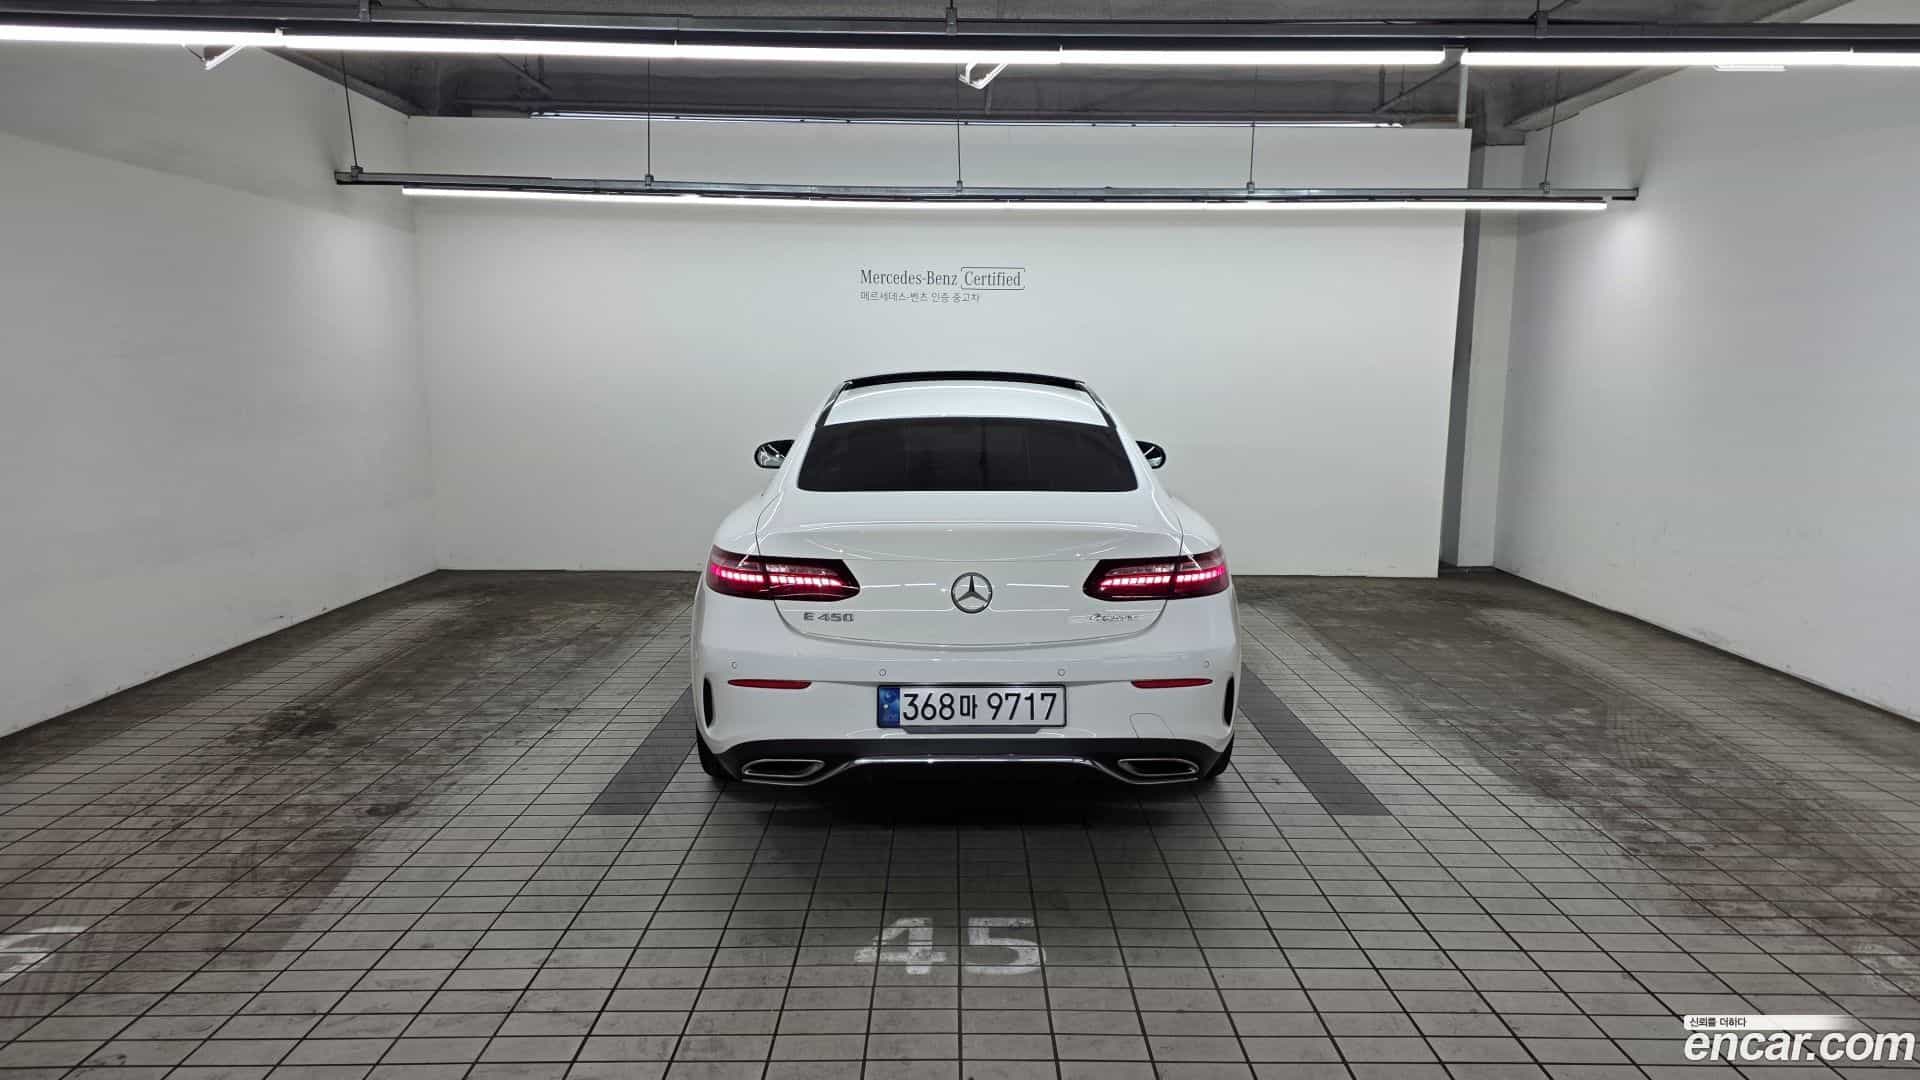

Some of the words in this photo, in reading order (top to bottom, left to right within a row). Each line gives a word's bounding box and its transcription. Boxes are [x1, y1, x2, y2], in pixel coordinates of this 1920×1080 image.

[860, 269, 958, 286] Mercedes-Benz
[964, 271, 1021, 287] Certified
[931, 292, 950, 303] 인증
[952, 292, 979, 304] 중고차
[803, 612, 814, 621] E
[903, 692, 978, 720] 368마
[987, 692, 1057, 720] 9717
[854, 917, 1046, 975] 45
